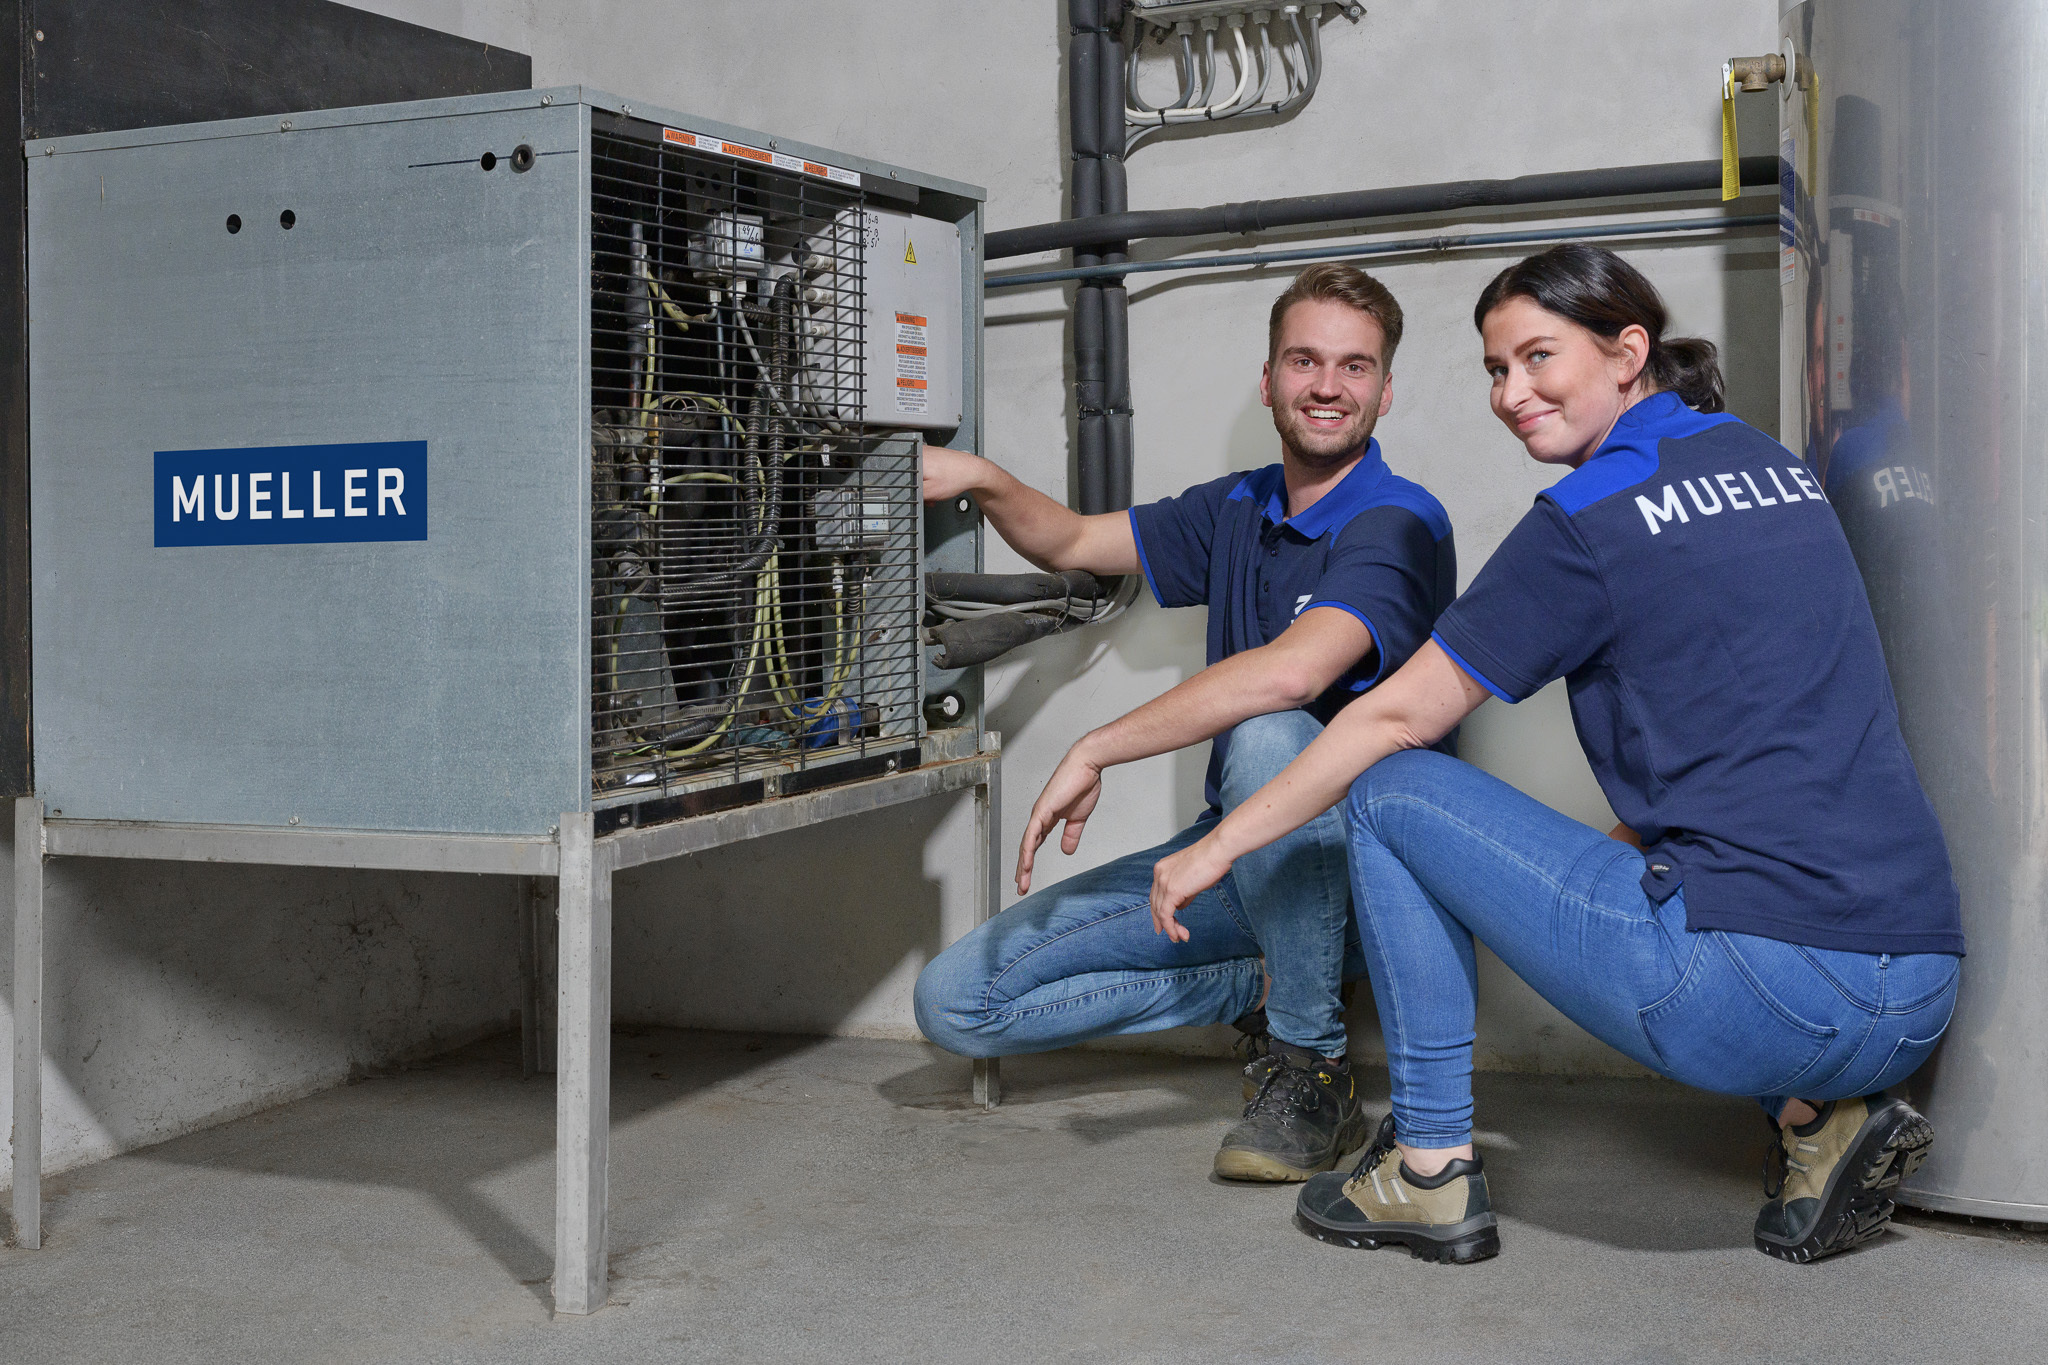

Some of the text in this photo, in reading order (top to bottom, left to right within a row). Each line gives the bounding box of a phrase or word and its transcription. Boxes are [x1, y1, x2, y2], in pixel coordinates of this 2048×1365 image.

[670, 131, 696, 145] WARNING
[808, 164, 827, 176] PELIGRO
[172, 467, 407, 522] MUELLER
[1634, 467, 1829, 536] MUELLE
